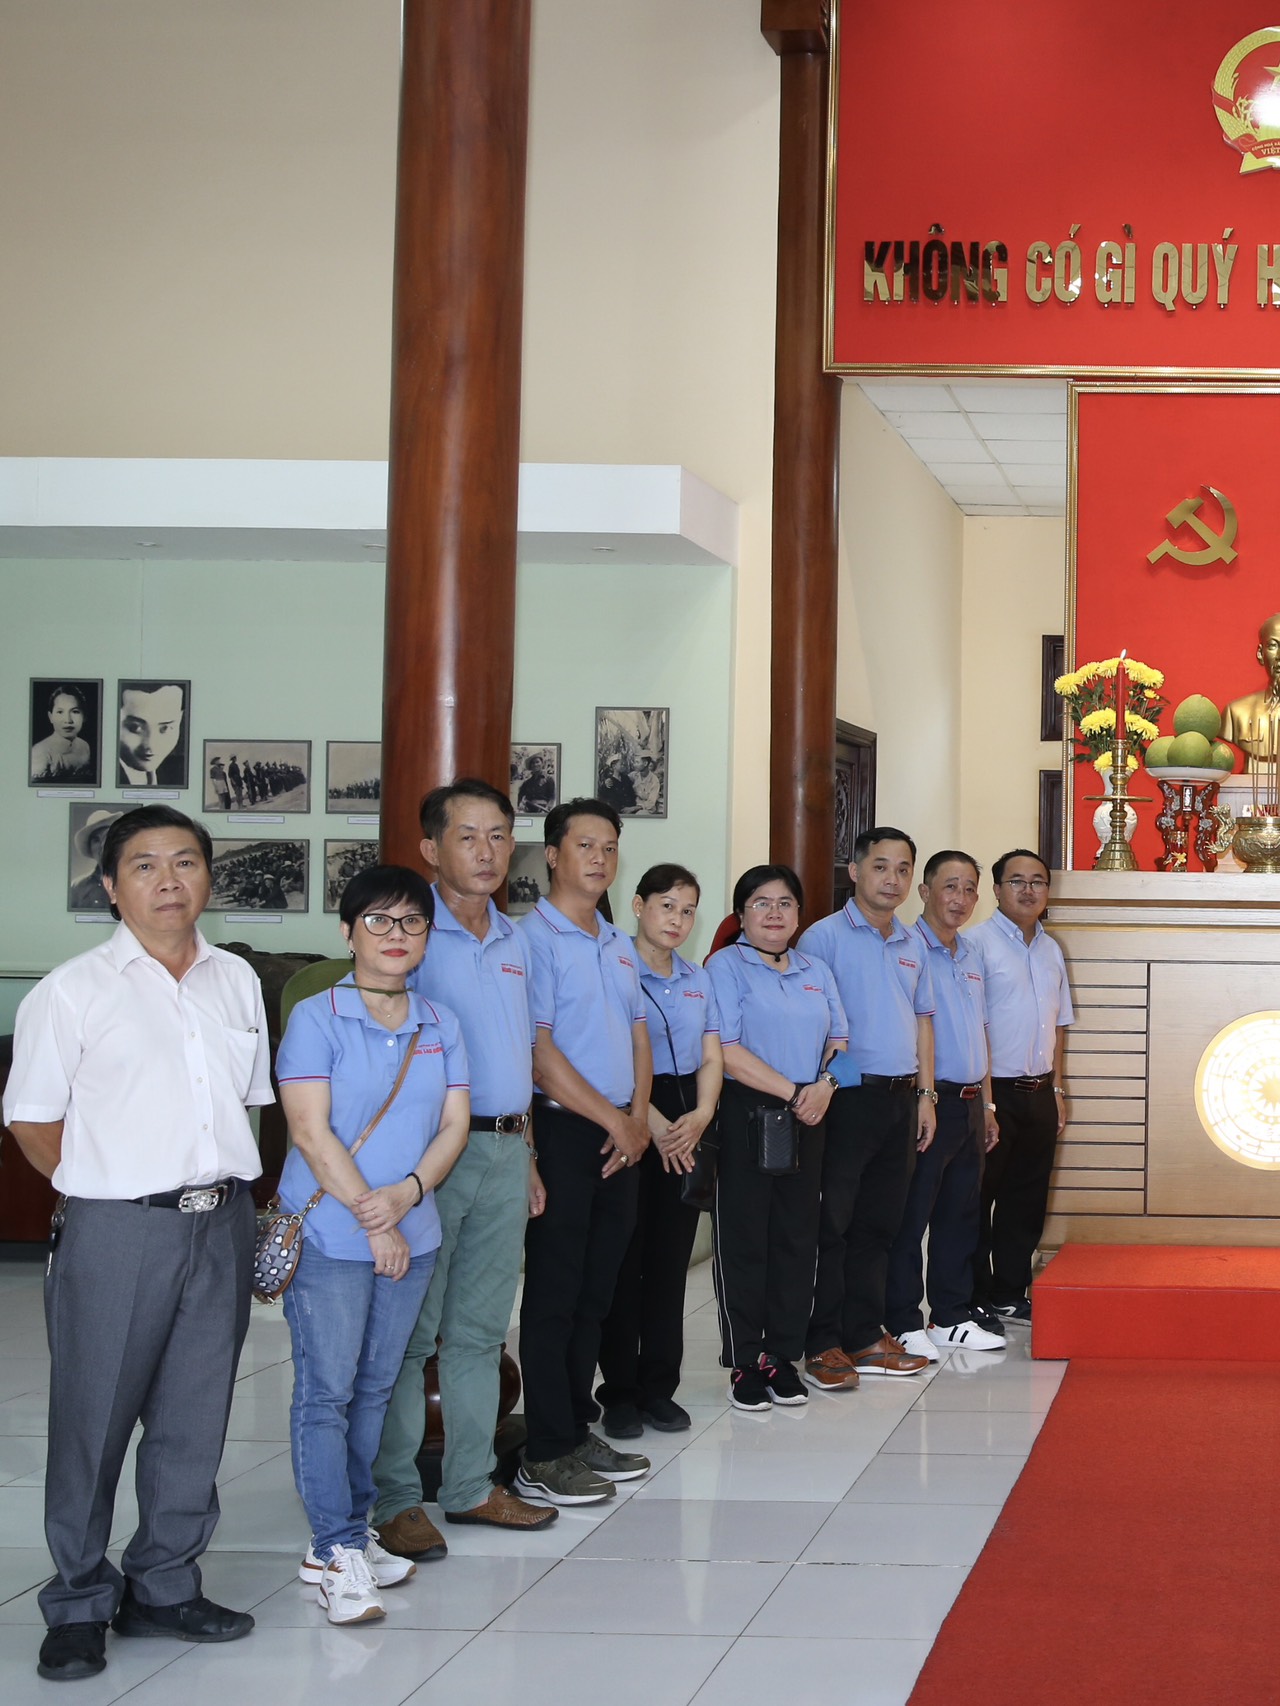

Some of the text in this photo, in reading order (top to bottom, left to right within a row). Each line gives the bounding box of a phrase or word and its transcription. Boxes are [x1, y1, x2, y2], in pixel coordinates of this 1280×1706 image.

[864, 223, 1008, 304] KHÔNG
[1025, 223, 1082, 304] CÓ
[1095, 223, 1136, 304] GÌ
[1152, 227, 1239, 311] QUÝ
